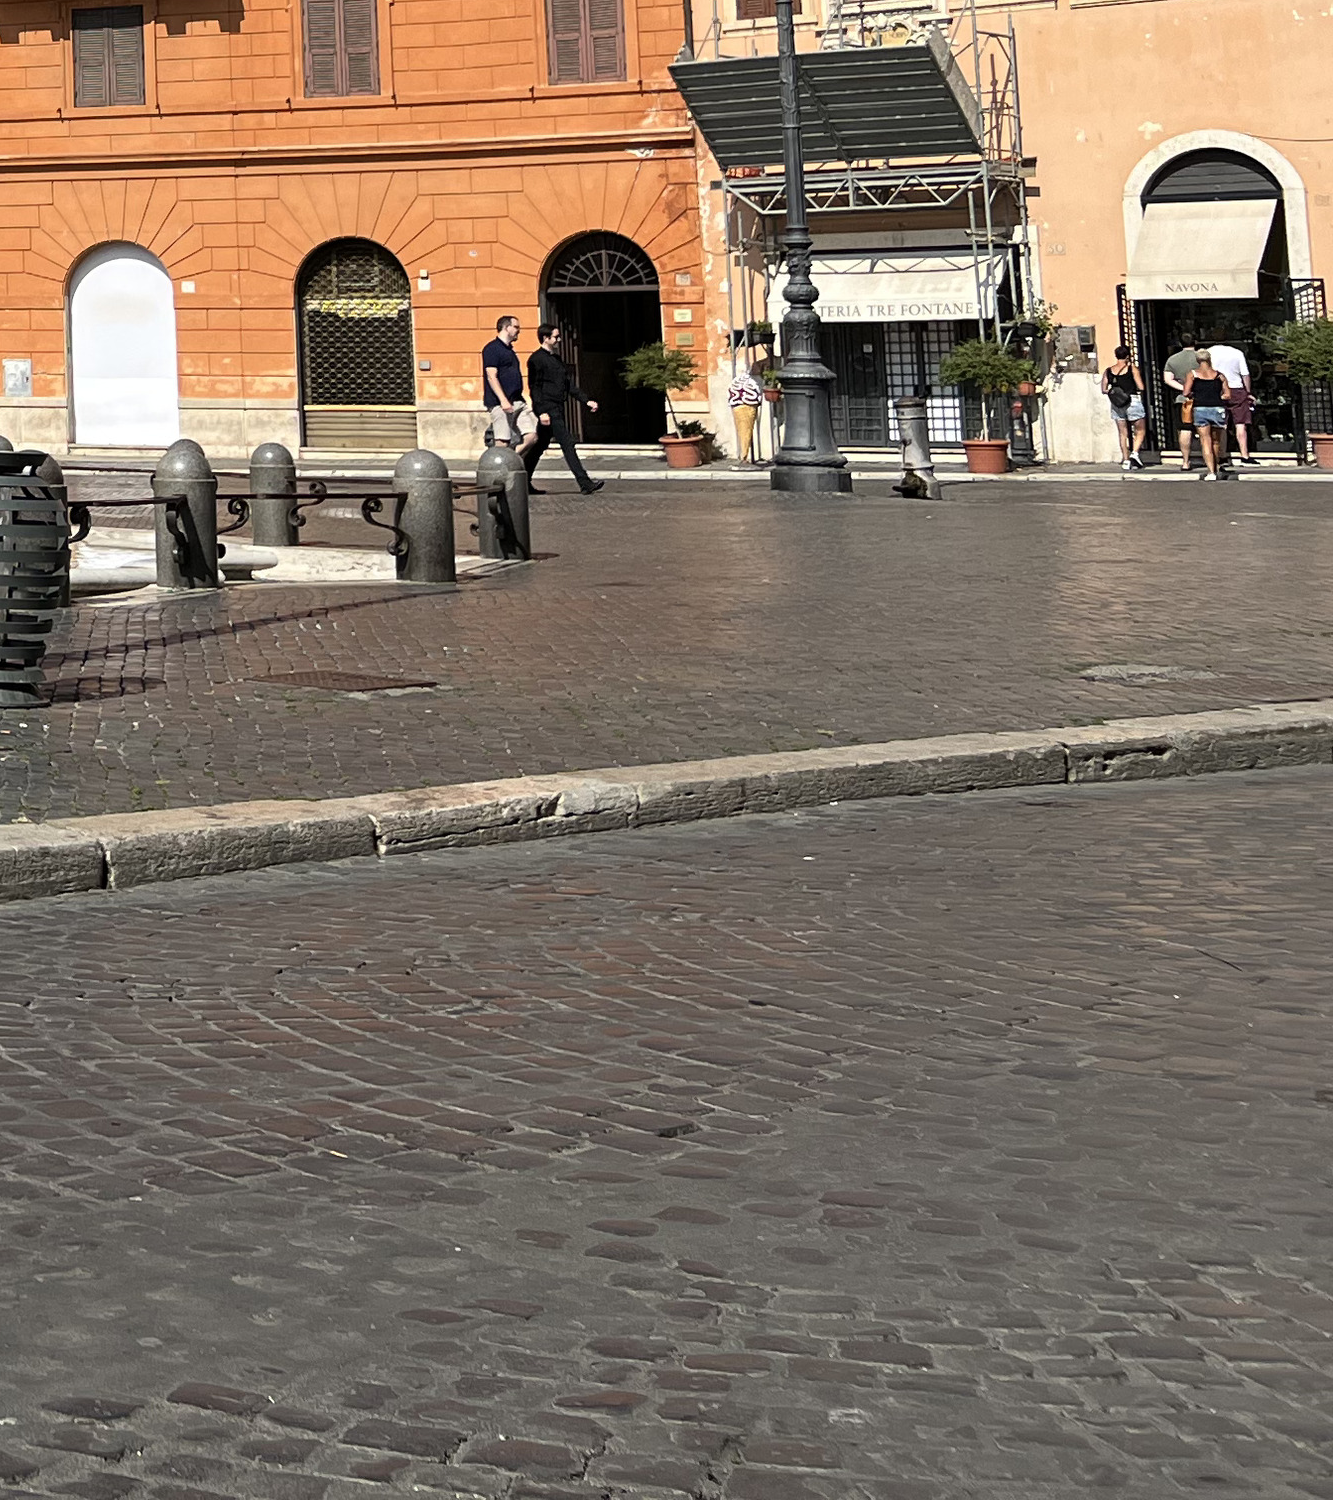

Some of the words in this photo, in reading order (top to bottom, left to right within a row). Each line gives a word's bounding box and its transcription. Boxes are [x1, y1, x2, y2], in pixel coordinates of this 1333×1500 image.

[1165, 283, 1219, 293] NAVONA
[781, 305, 861, 318] TERIA
[867, 305, 896, 317] TRE
[900, 302, 975, 317] FONTANE
